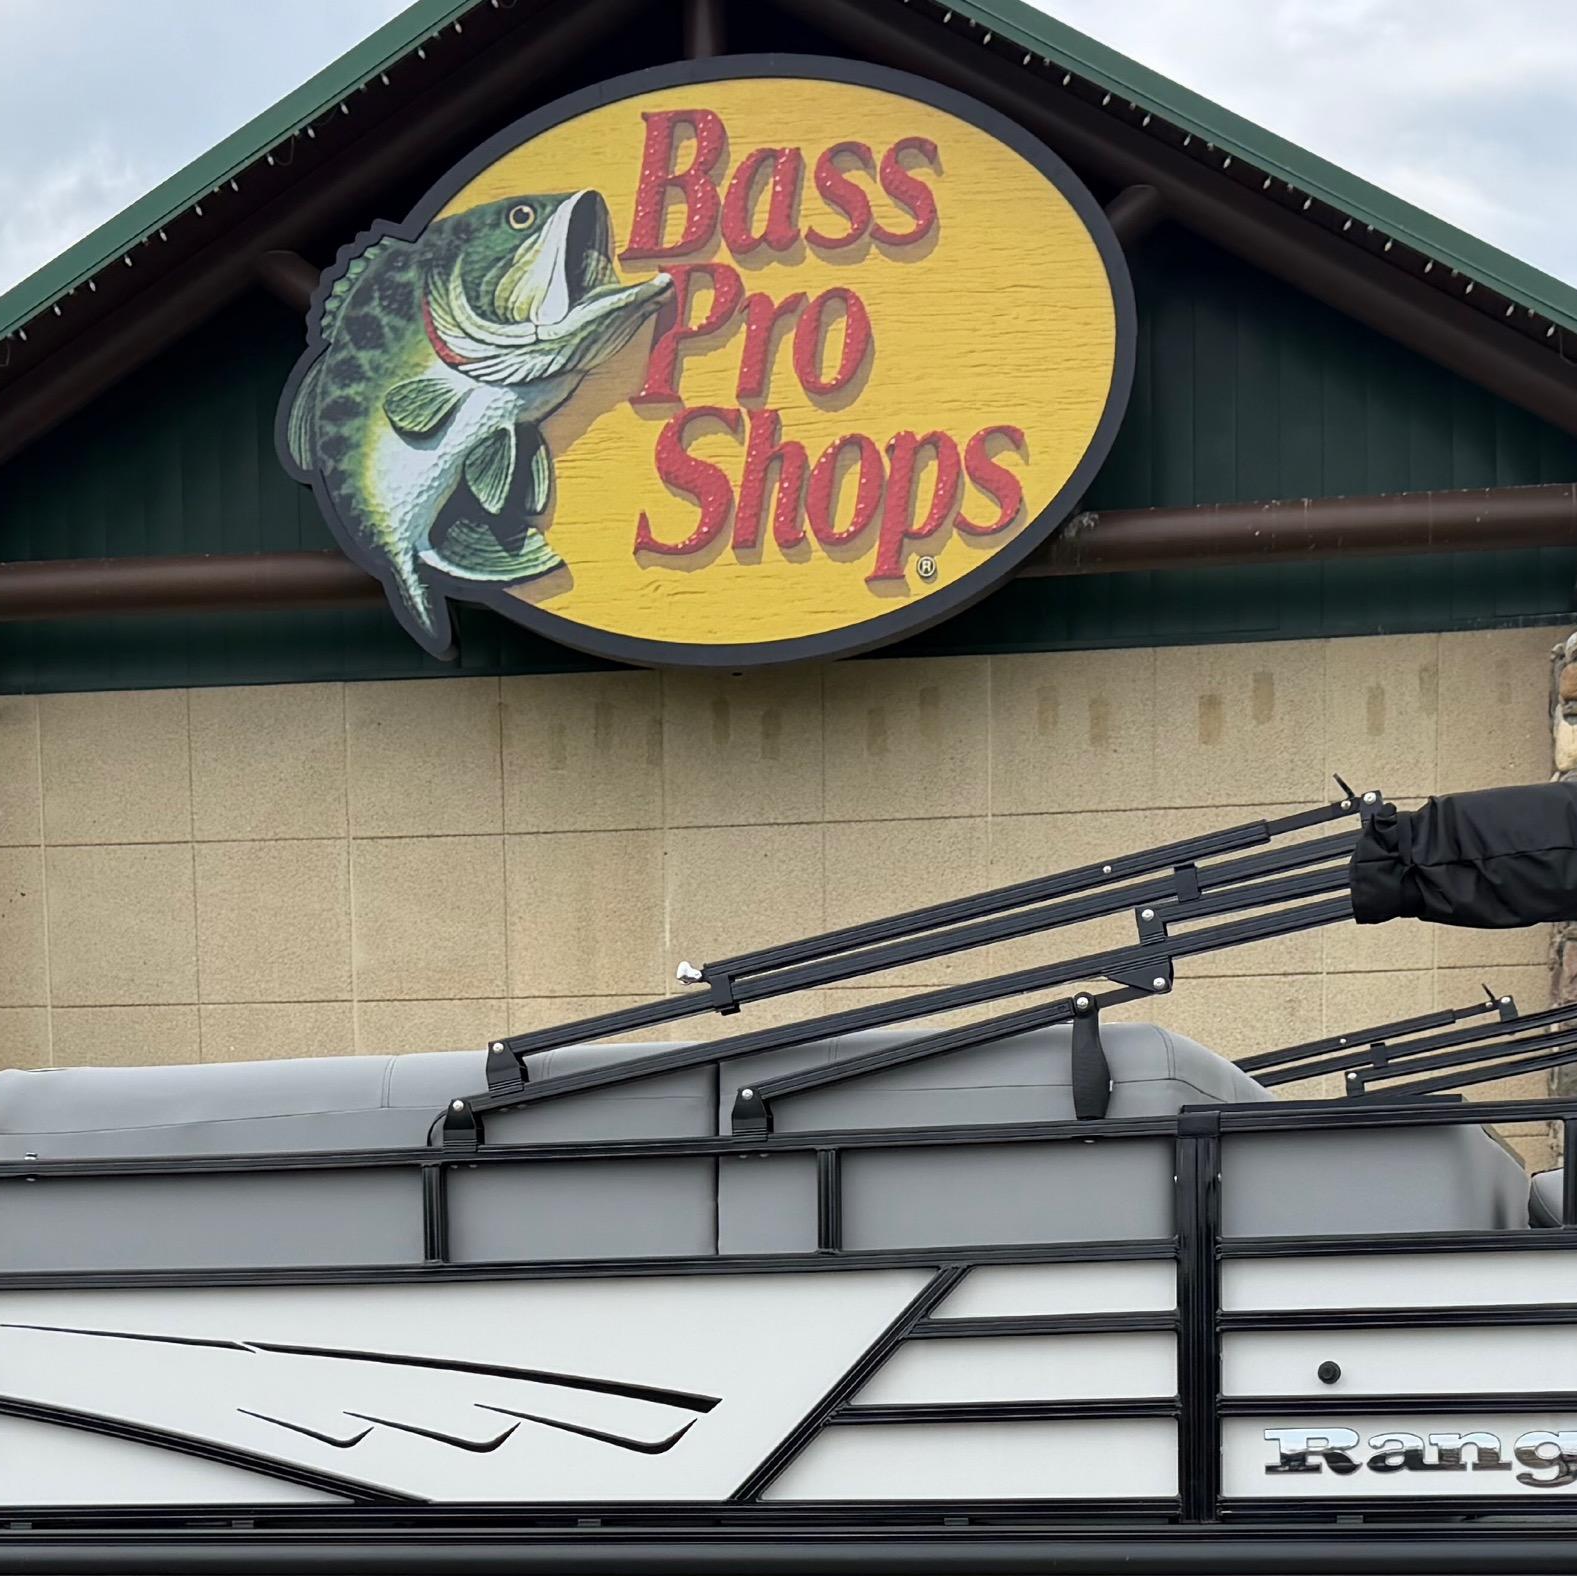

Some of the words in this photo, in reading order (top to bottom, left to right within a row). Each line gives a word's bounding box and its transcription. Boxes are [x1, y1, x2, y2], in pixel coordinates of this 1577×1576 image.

[617, 107, 939, 262] Bass
[629, 262, 872, 405] Pro
[634, 405, 1027, 583] Shops
